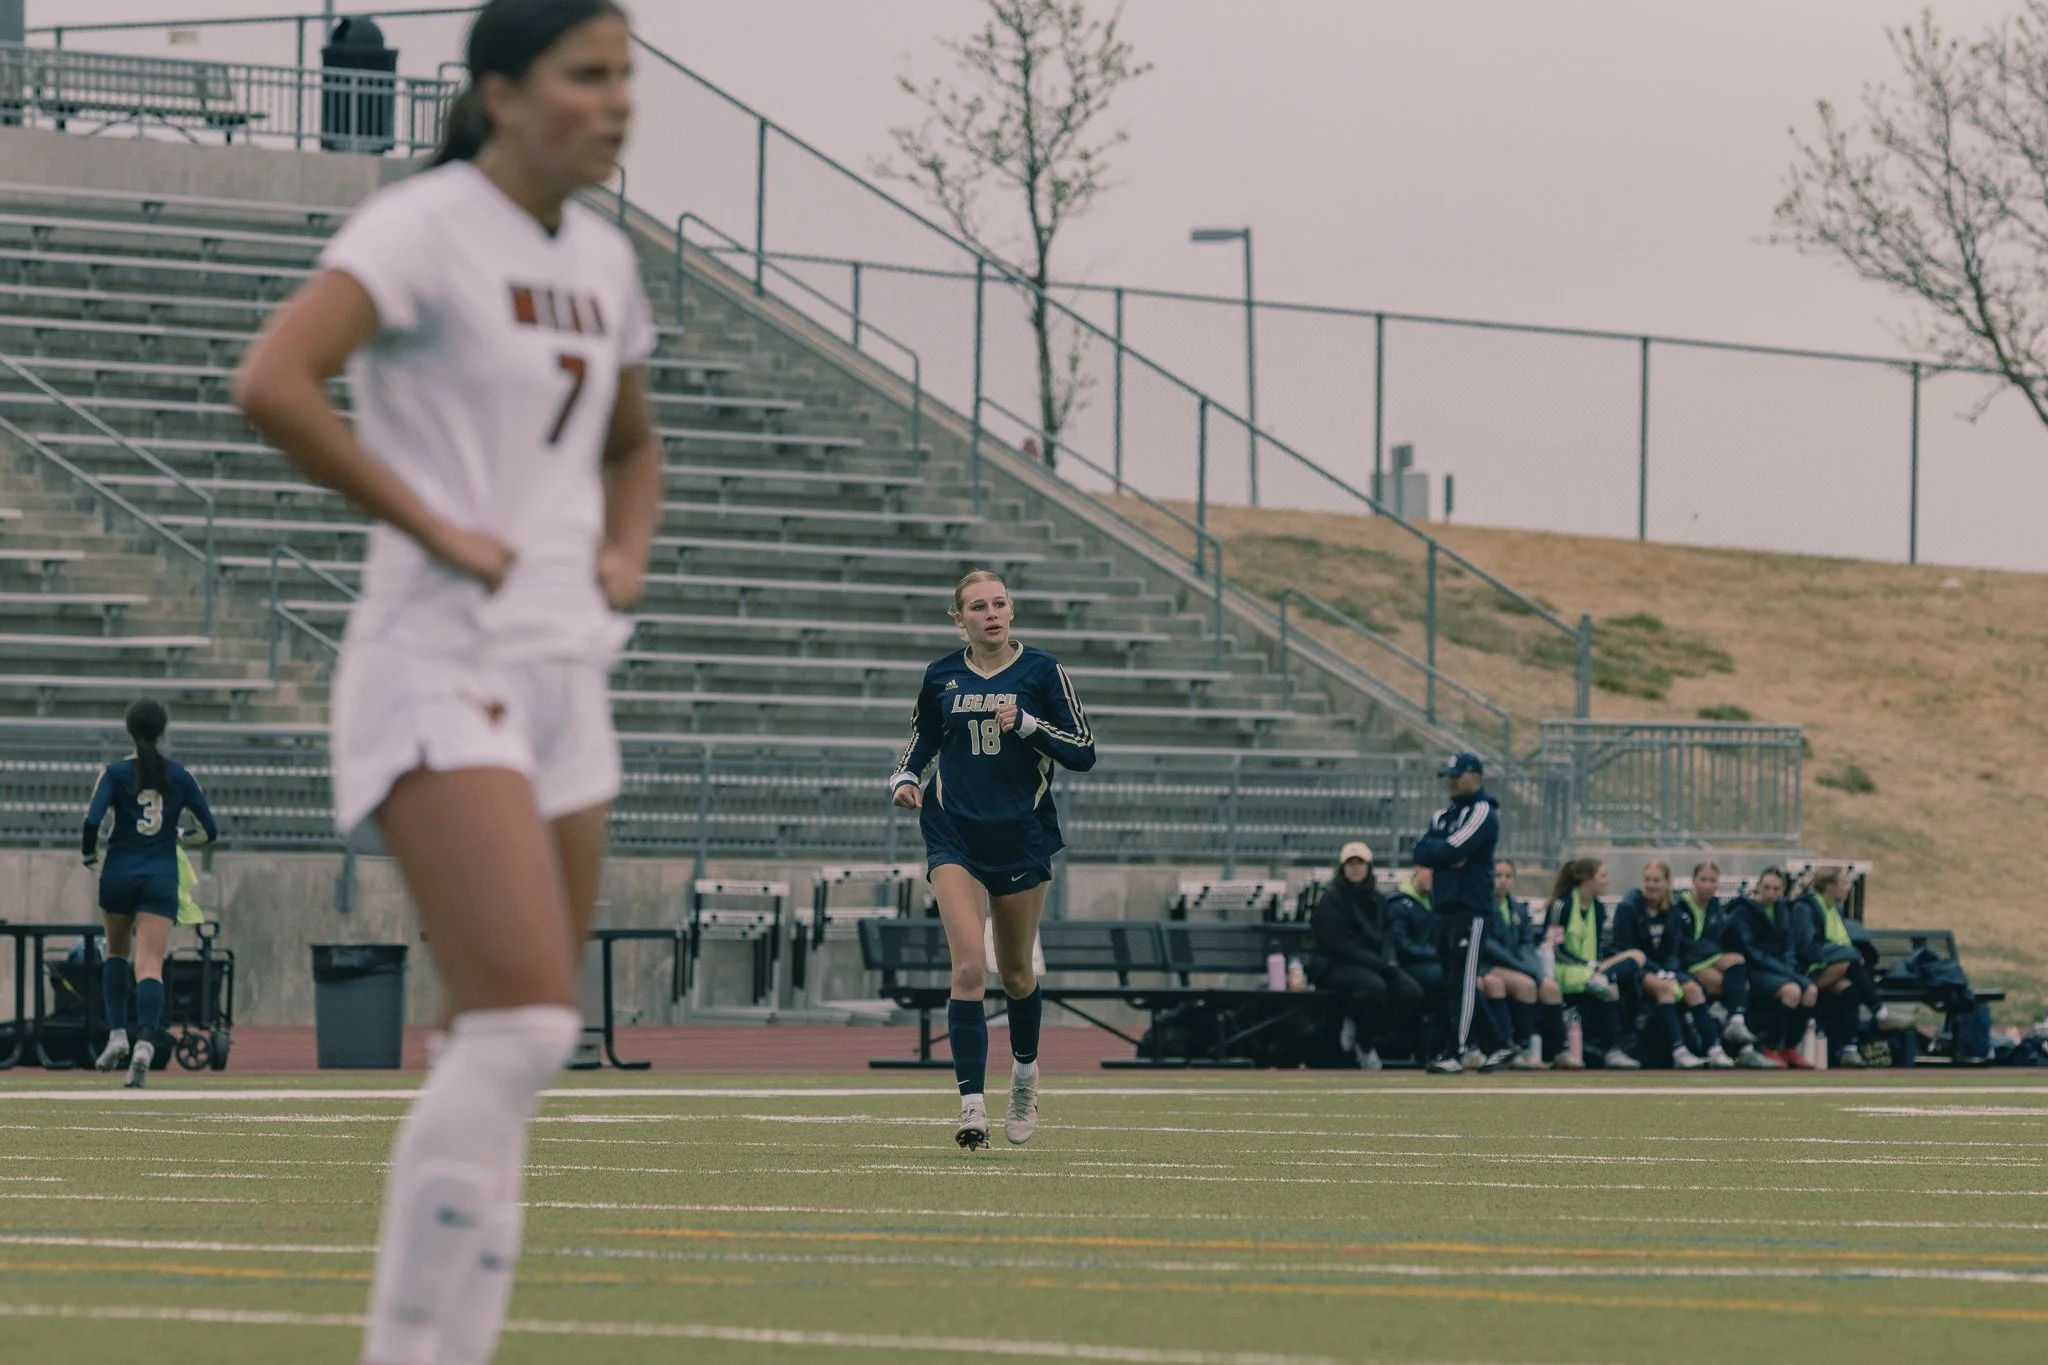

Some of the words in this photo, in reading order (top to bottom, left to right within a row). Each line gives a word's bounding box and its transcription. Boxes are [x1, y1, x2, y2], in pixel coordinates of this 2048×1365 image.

[548, 353, 587, 446] 7
[967, 719, 1001, 756] 18
[136, 788, 163, 836] 3
